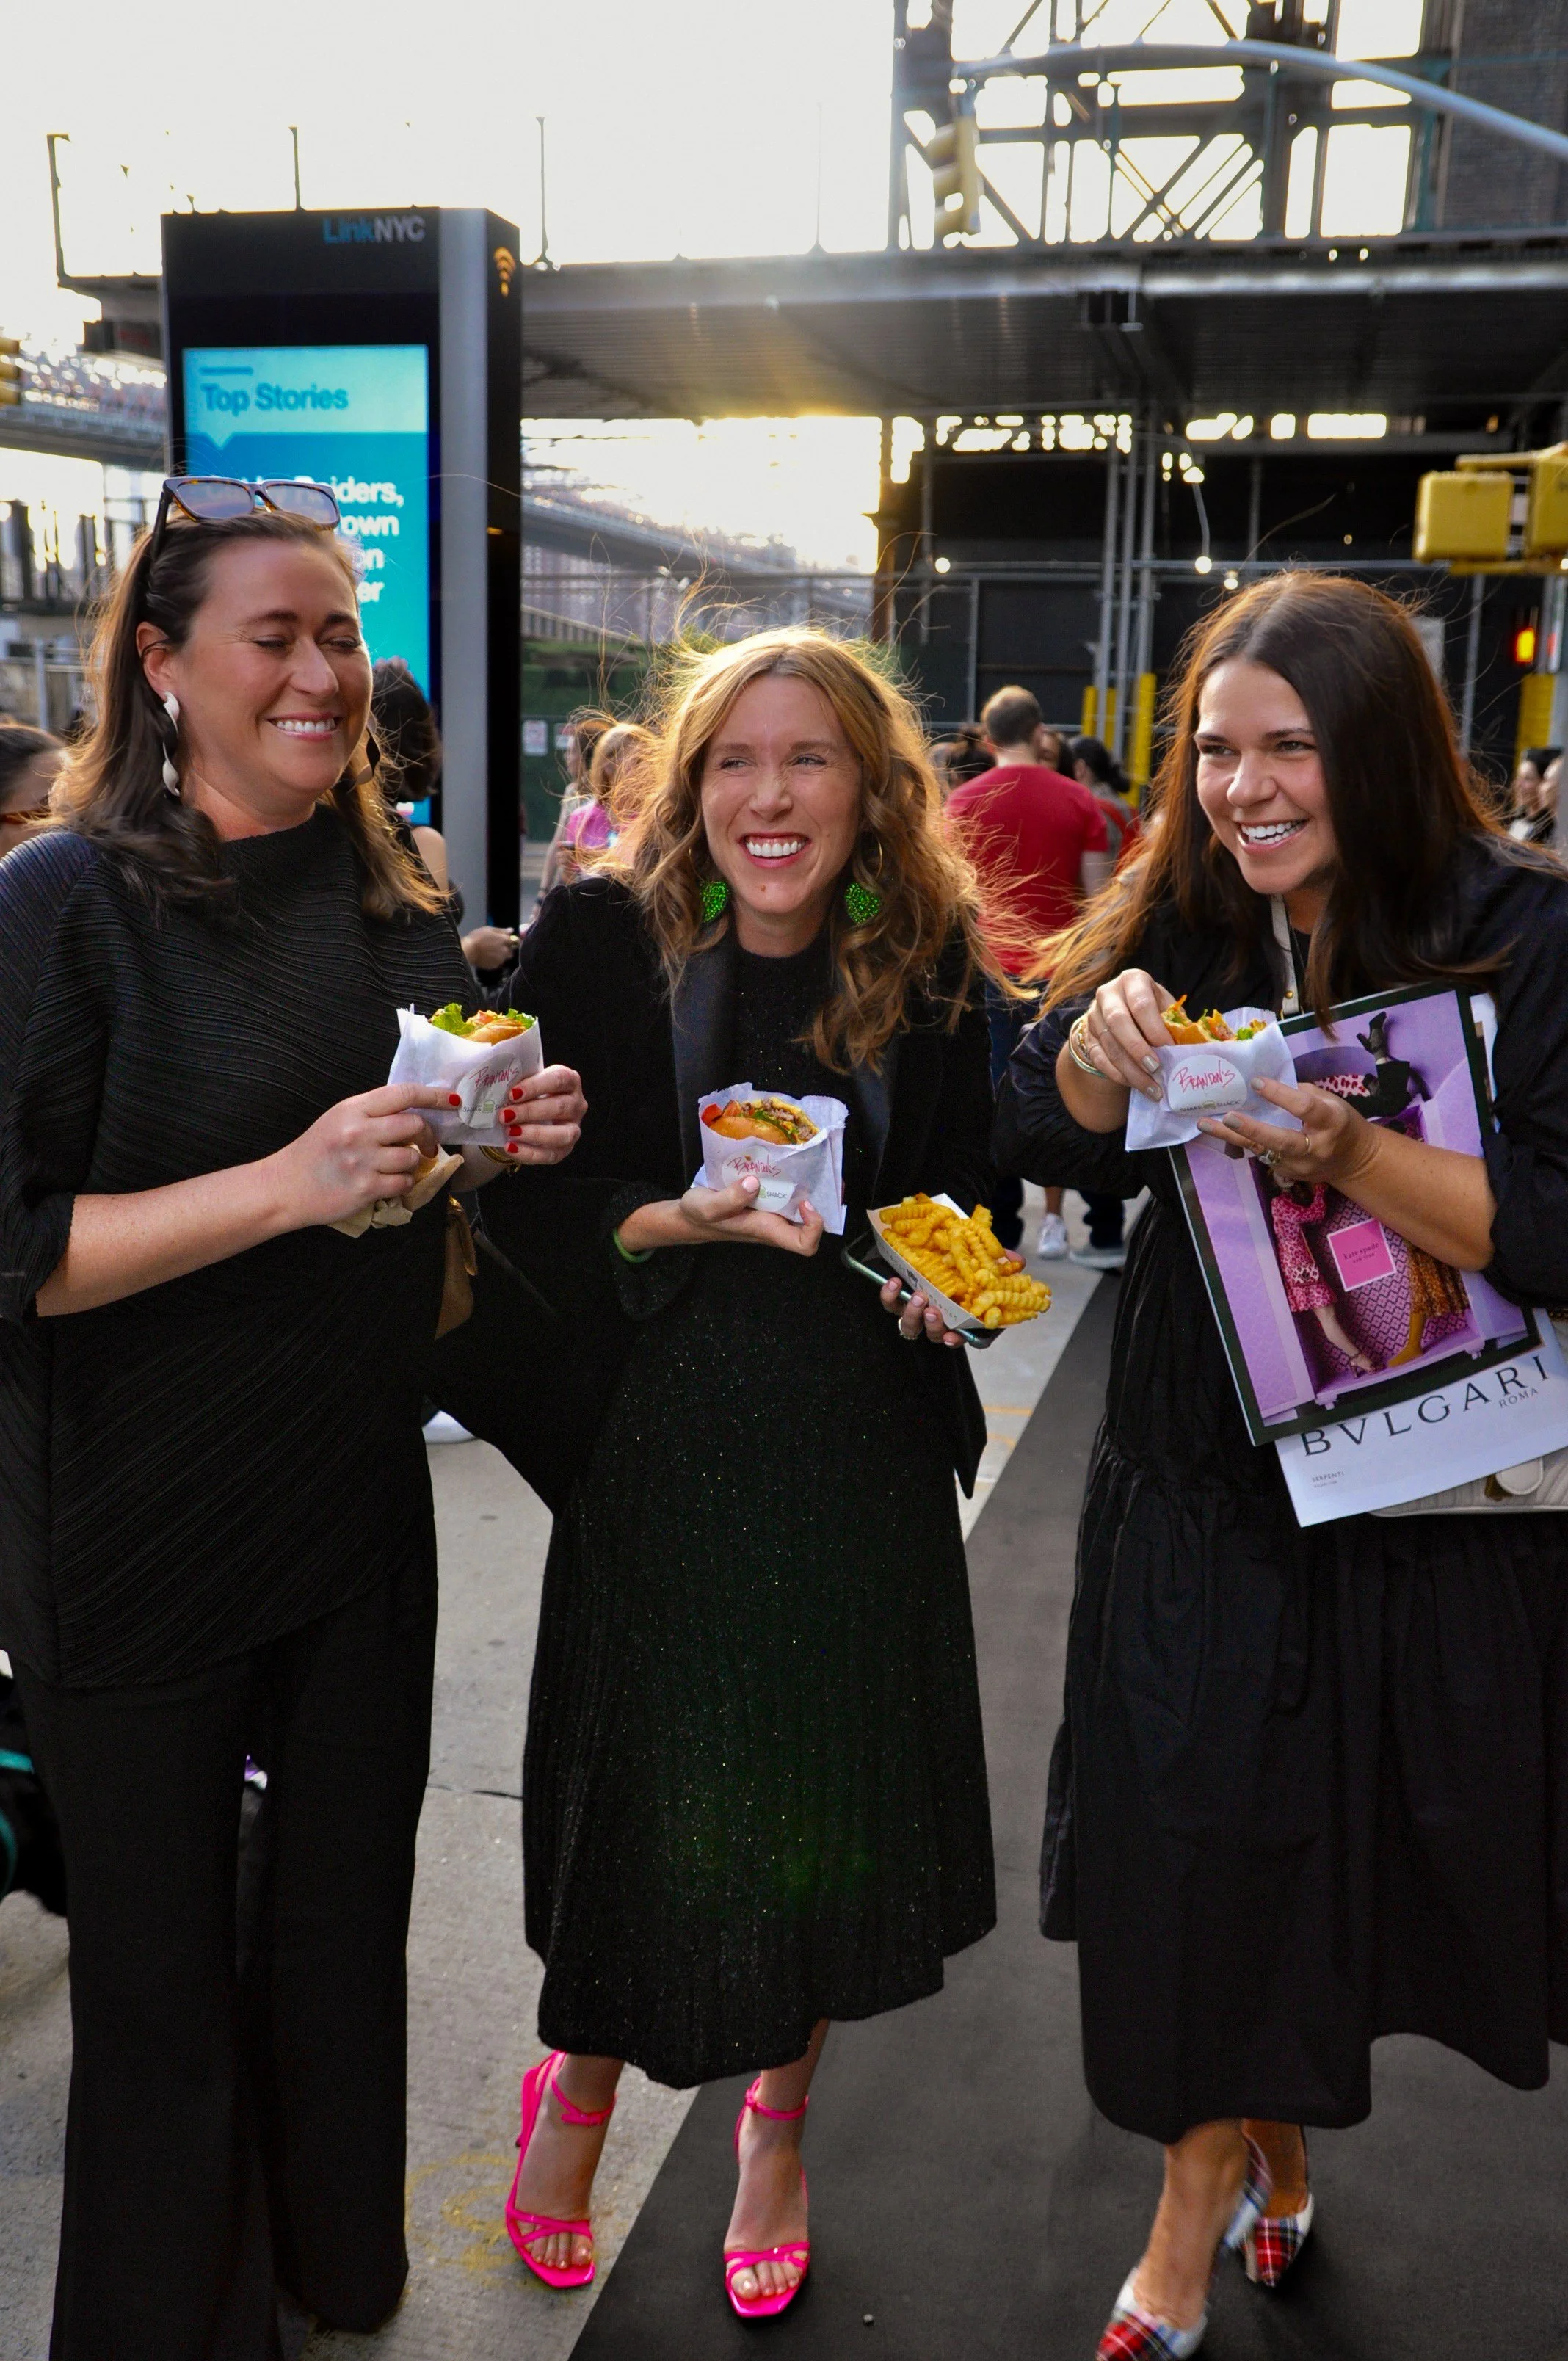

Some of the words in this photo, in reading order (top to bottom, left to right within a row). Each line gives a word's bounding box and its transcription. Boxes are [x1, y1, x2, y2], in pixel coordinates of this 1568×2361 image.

[323, 217, 425, 244] LinkNYC
[200, 383, 250, 416] Top
[255, 382, 349, 410] Stories
[339, 515, 399, 537] own
[766, 1190, 787, 1199] SHACK
[1301, 1355, 1549, 1457] BVLGARI
[1498, 1387, 1539, 1409] ROMA
